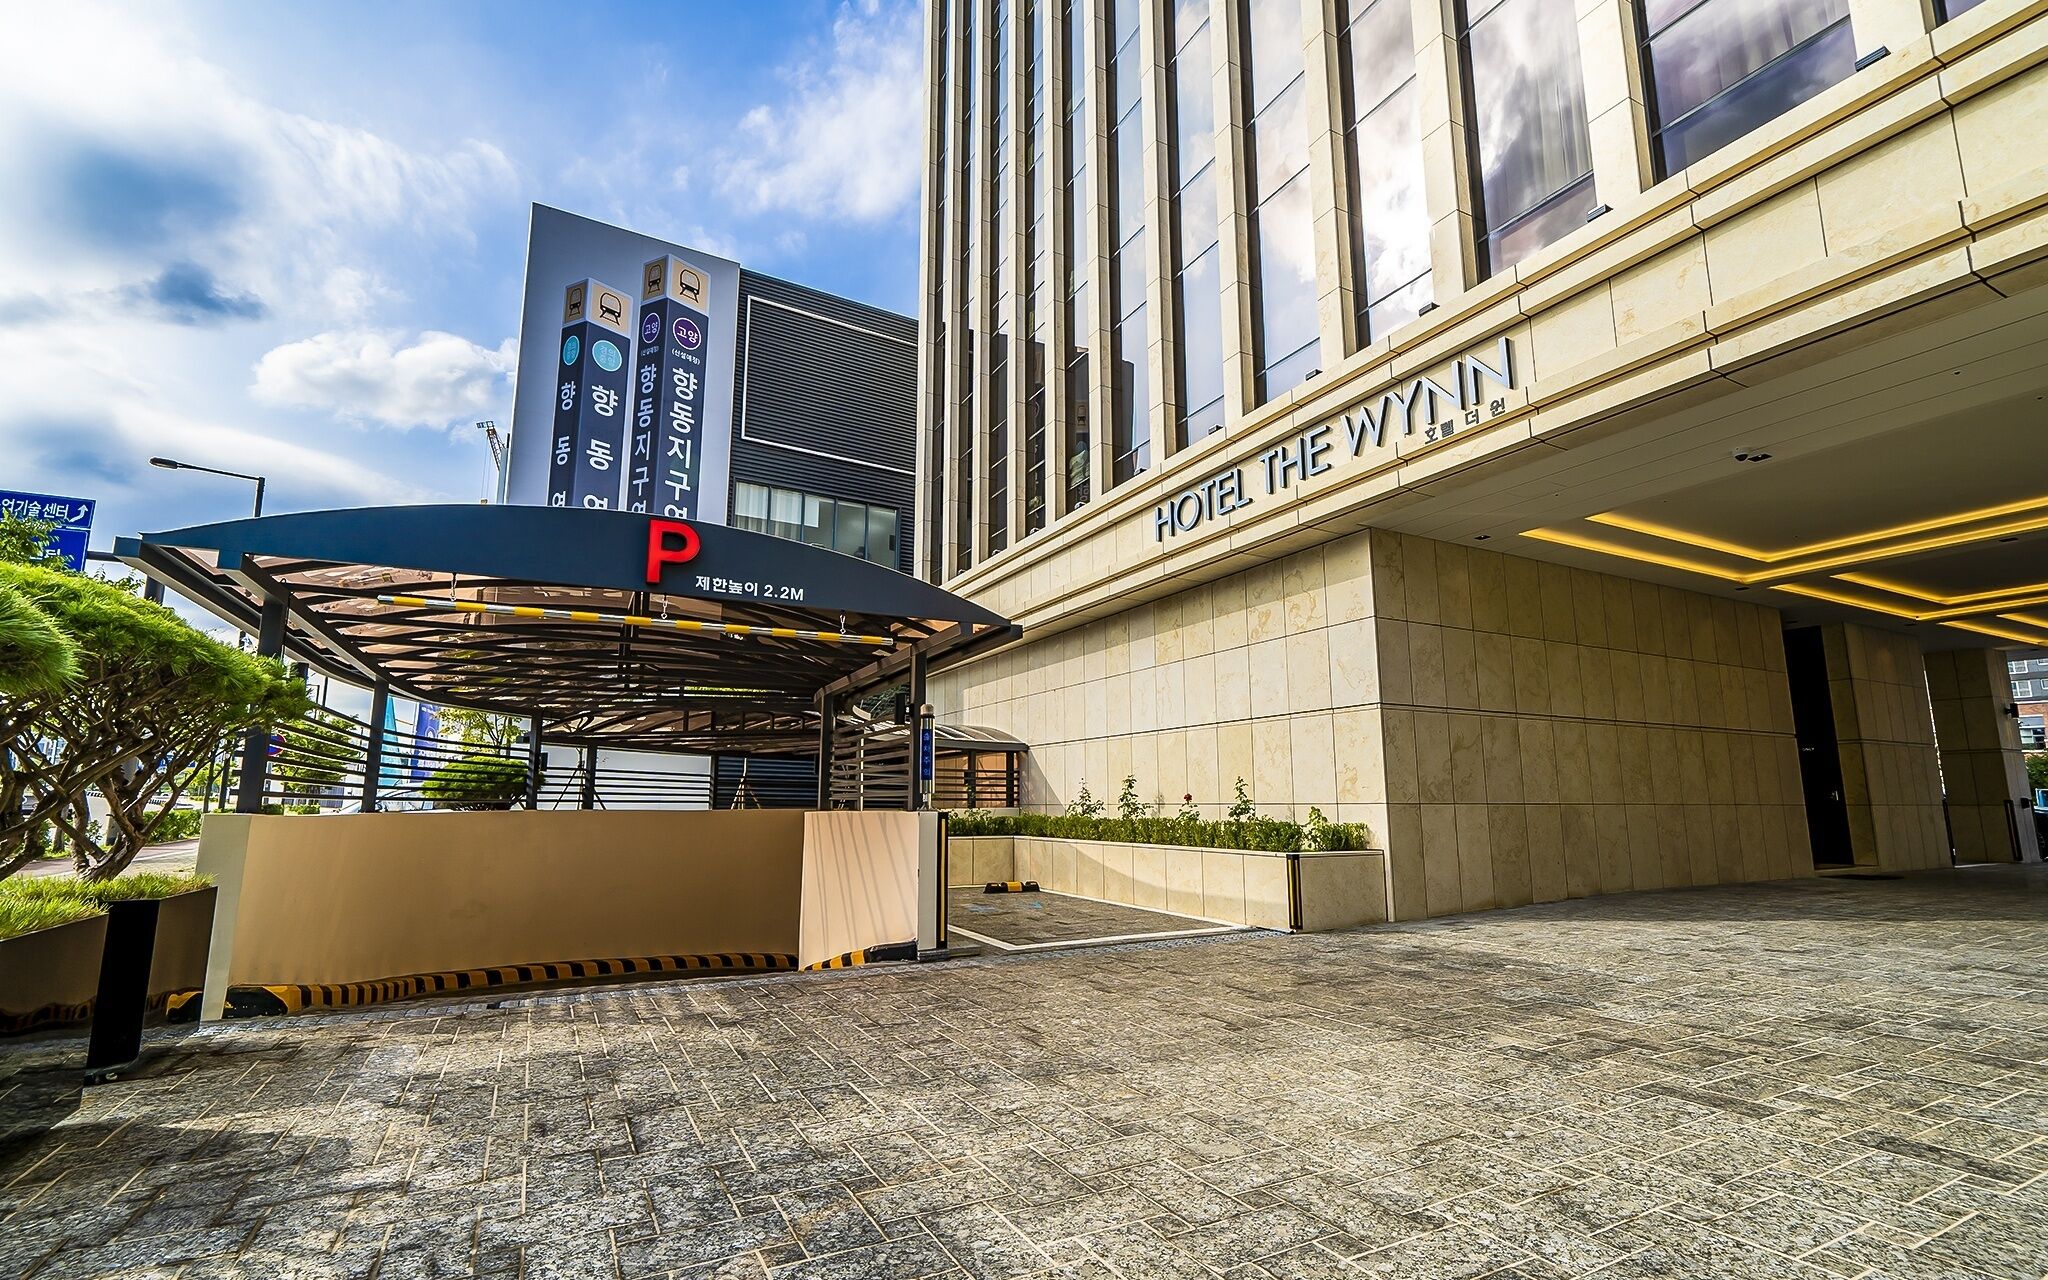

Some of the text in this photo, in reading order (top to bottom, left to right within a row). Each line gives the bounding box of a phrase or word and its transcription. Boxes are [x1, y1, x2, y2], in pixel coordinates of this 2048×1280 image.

[644, 321, 658, 334] 고양
[677, 325, 698, 343] 고양
[1155, 336, 1515, 542] HOTEL THE WYNN
[1424, 419, 1455, 445] 호텔
[646, 518, 701, 585] P
[695, 575, 804, 601] 제한높이 2.2M
